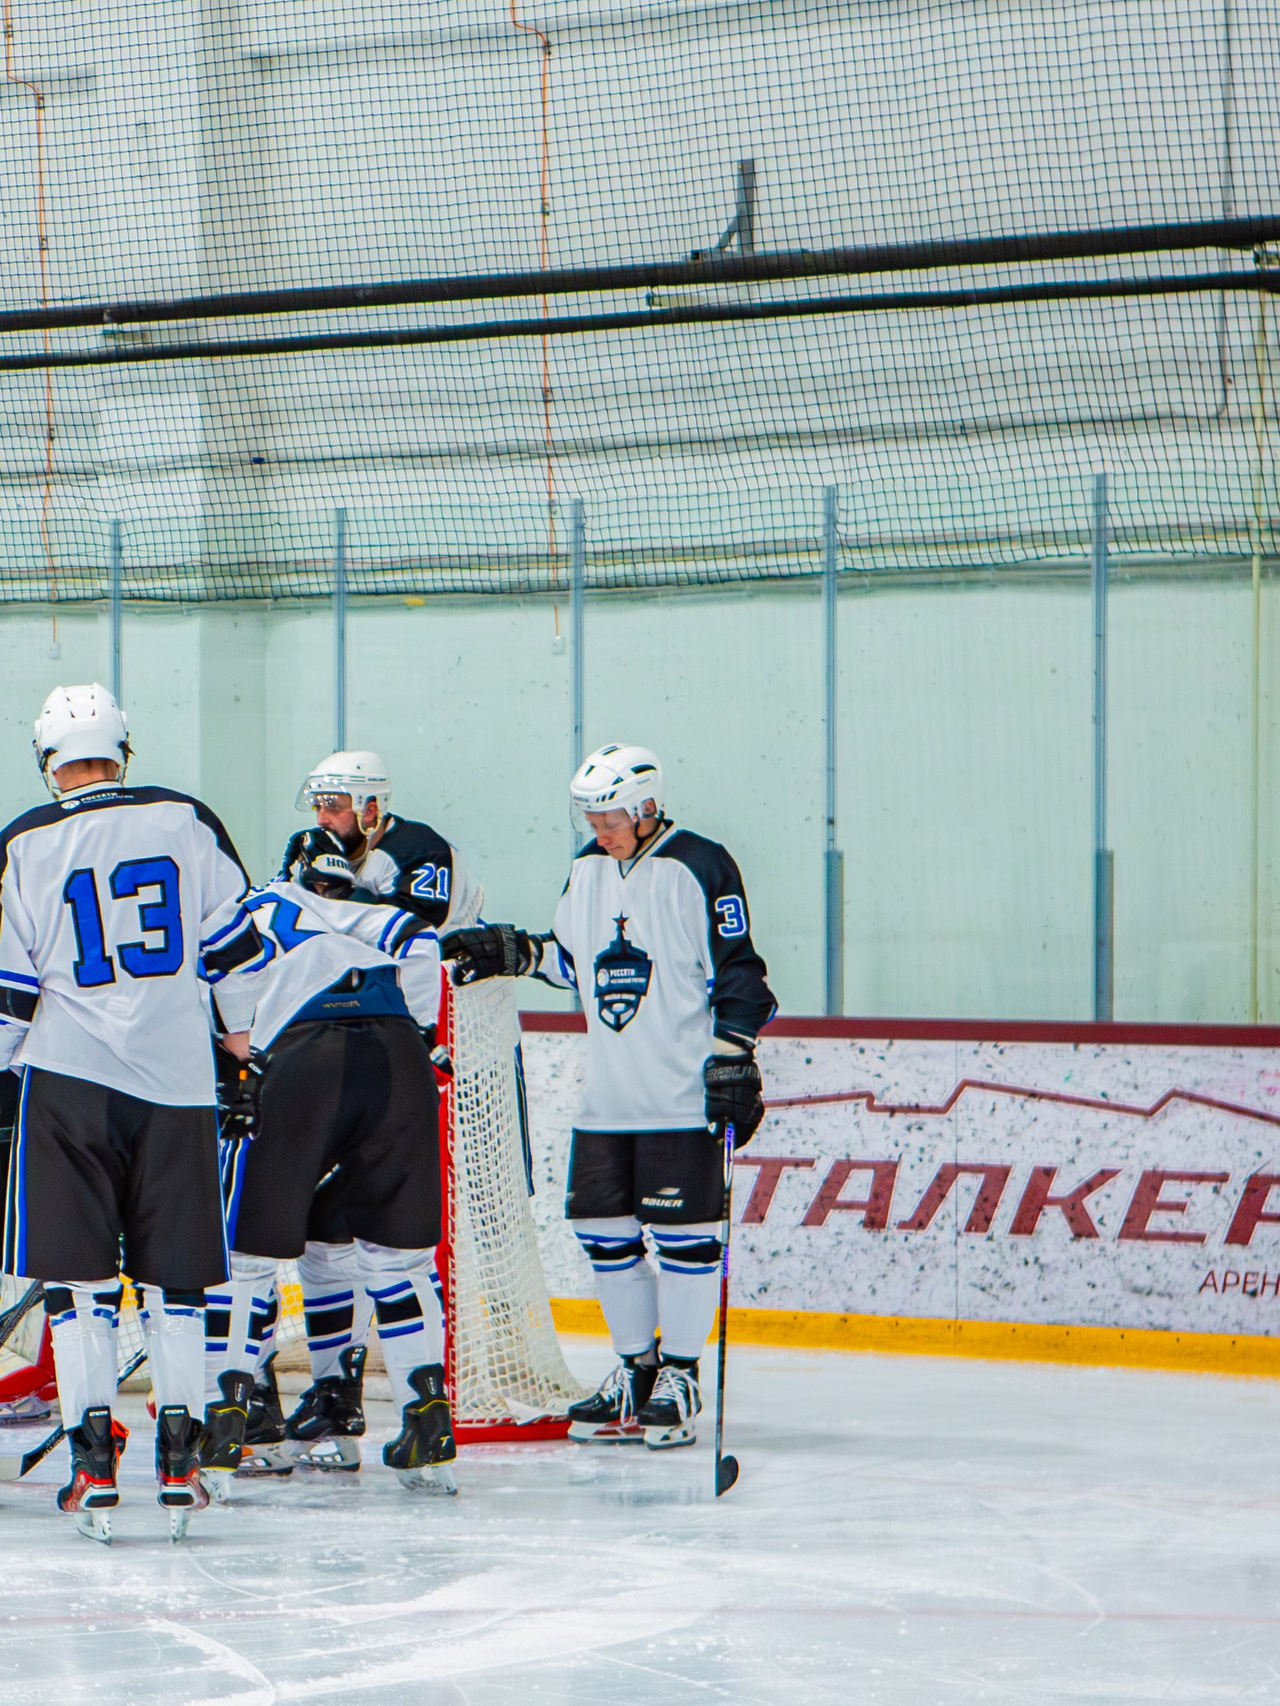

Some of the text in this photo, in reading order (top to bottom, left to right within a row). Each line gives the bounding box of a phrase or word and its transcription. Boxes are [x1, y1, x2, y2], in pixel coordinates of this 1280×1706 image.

[410, 862, 449, 901] 21
[62, 854, 184, 988] 13
[714, 894, 747, 938] 3
[641, 1197, 684, 1208] BAUER
